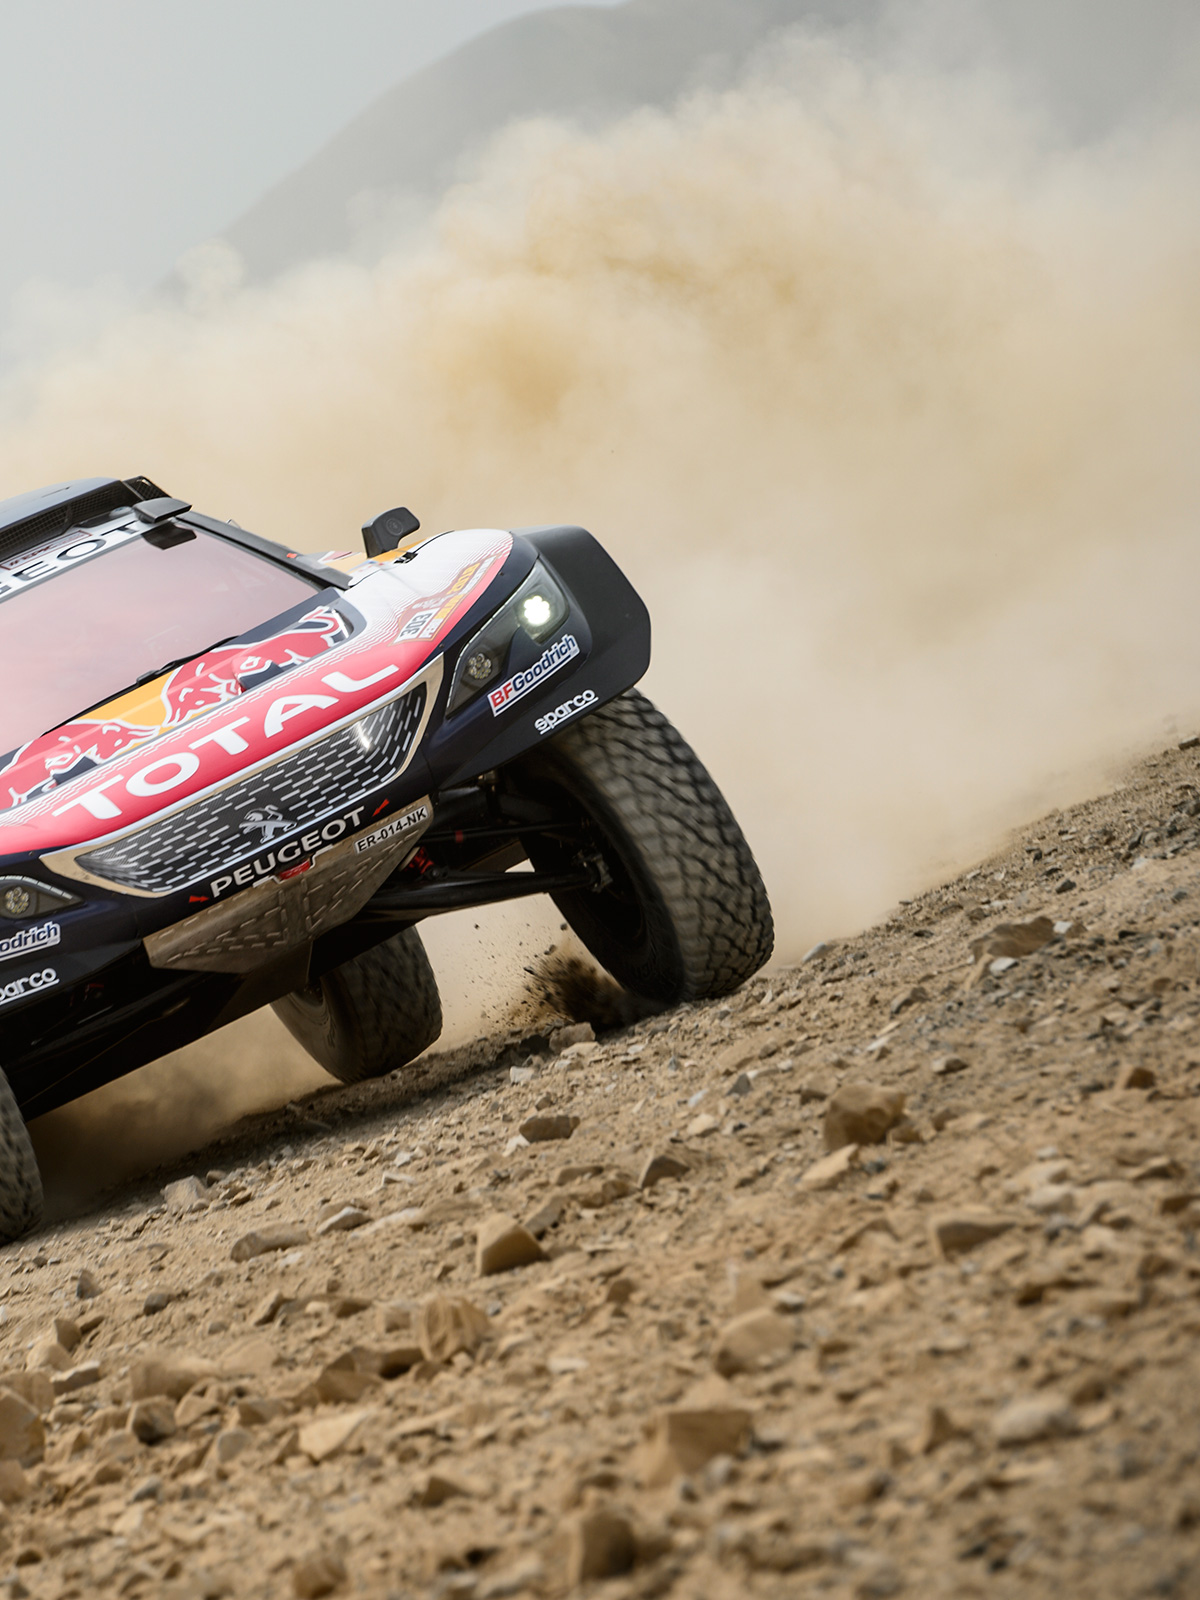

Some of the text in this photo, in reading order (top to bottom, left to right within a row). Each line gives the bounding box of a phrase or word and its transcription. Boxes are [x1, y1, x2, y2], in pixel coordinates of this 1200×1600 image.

[400, 612, 433, 638] 303
[490, 635, 577, 709] BFGoodrich
[534, 689, 597, 730] sparco
[52, 664, 400, 820] TOTAL
[210, 805, 365, 898] PEUGEOT
[357, 806, 429, 852] ER-014-NK
